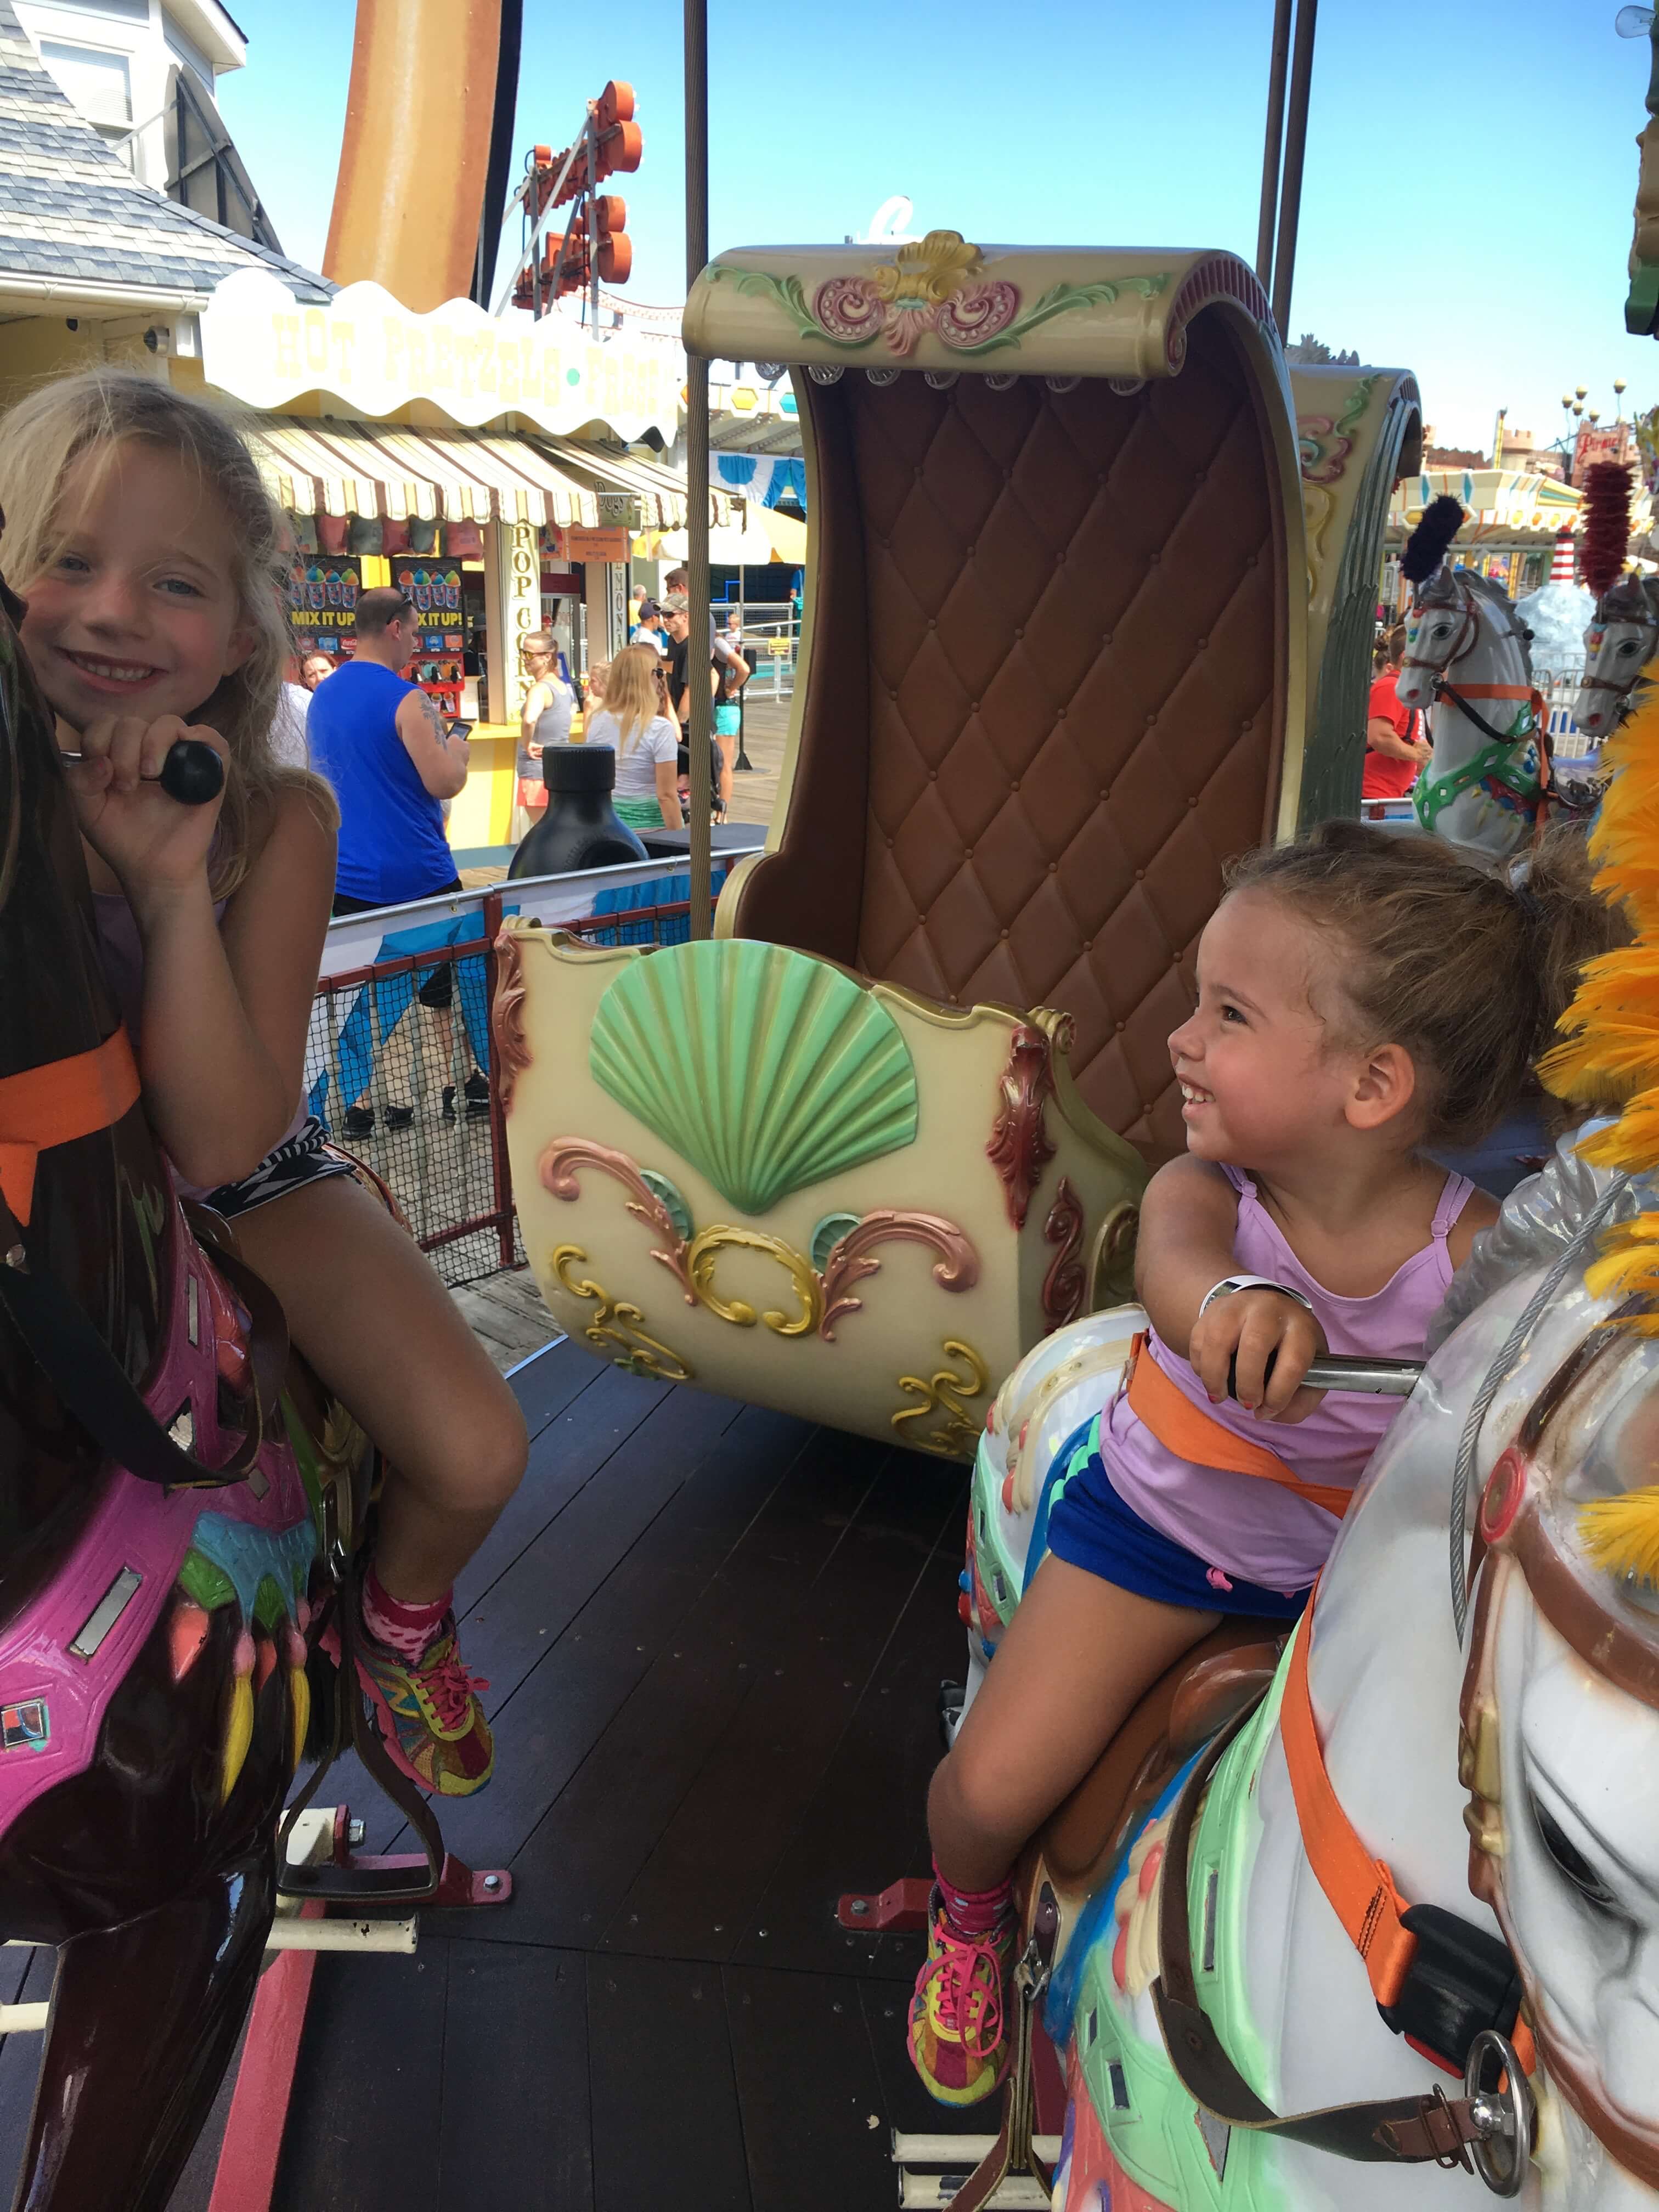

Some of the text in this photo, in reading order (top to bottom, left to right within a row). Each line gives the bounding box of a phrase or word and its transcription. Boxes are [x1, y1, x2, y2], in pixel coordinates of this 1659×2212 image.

[271, 308, 355, 385] HOT
[383, 315, 561, 407] PRETZELS
[514, 526, 532, 597] POP
[292, 611, 356, 626] MIX IT UP
[428, 613, 439, 625] IT
[441, 613, 462, 625] UP!
